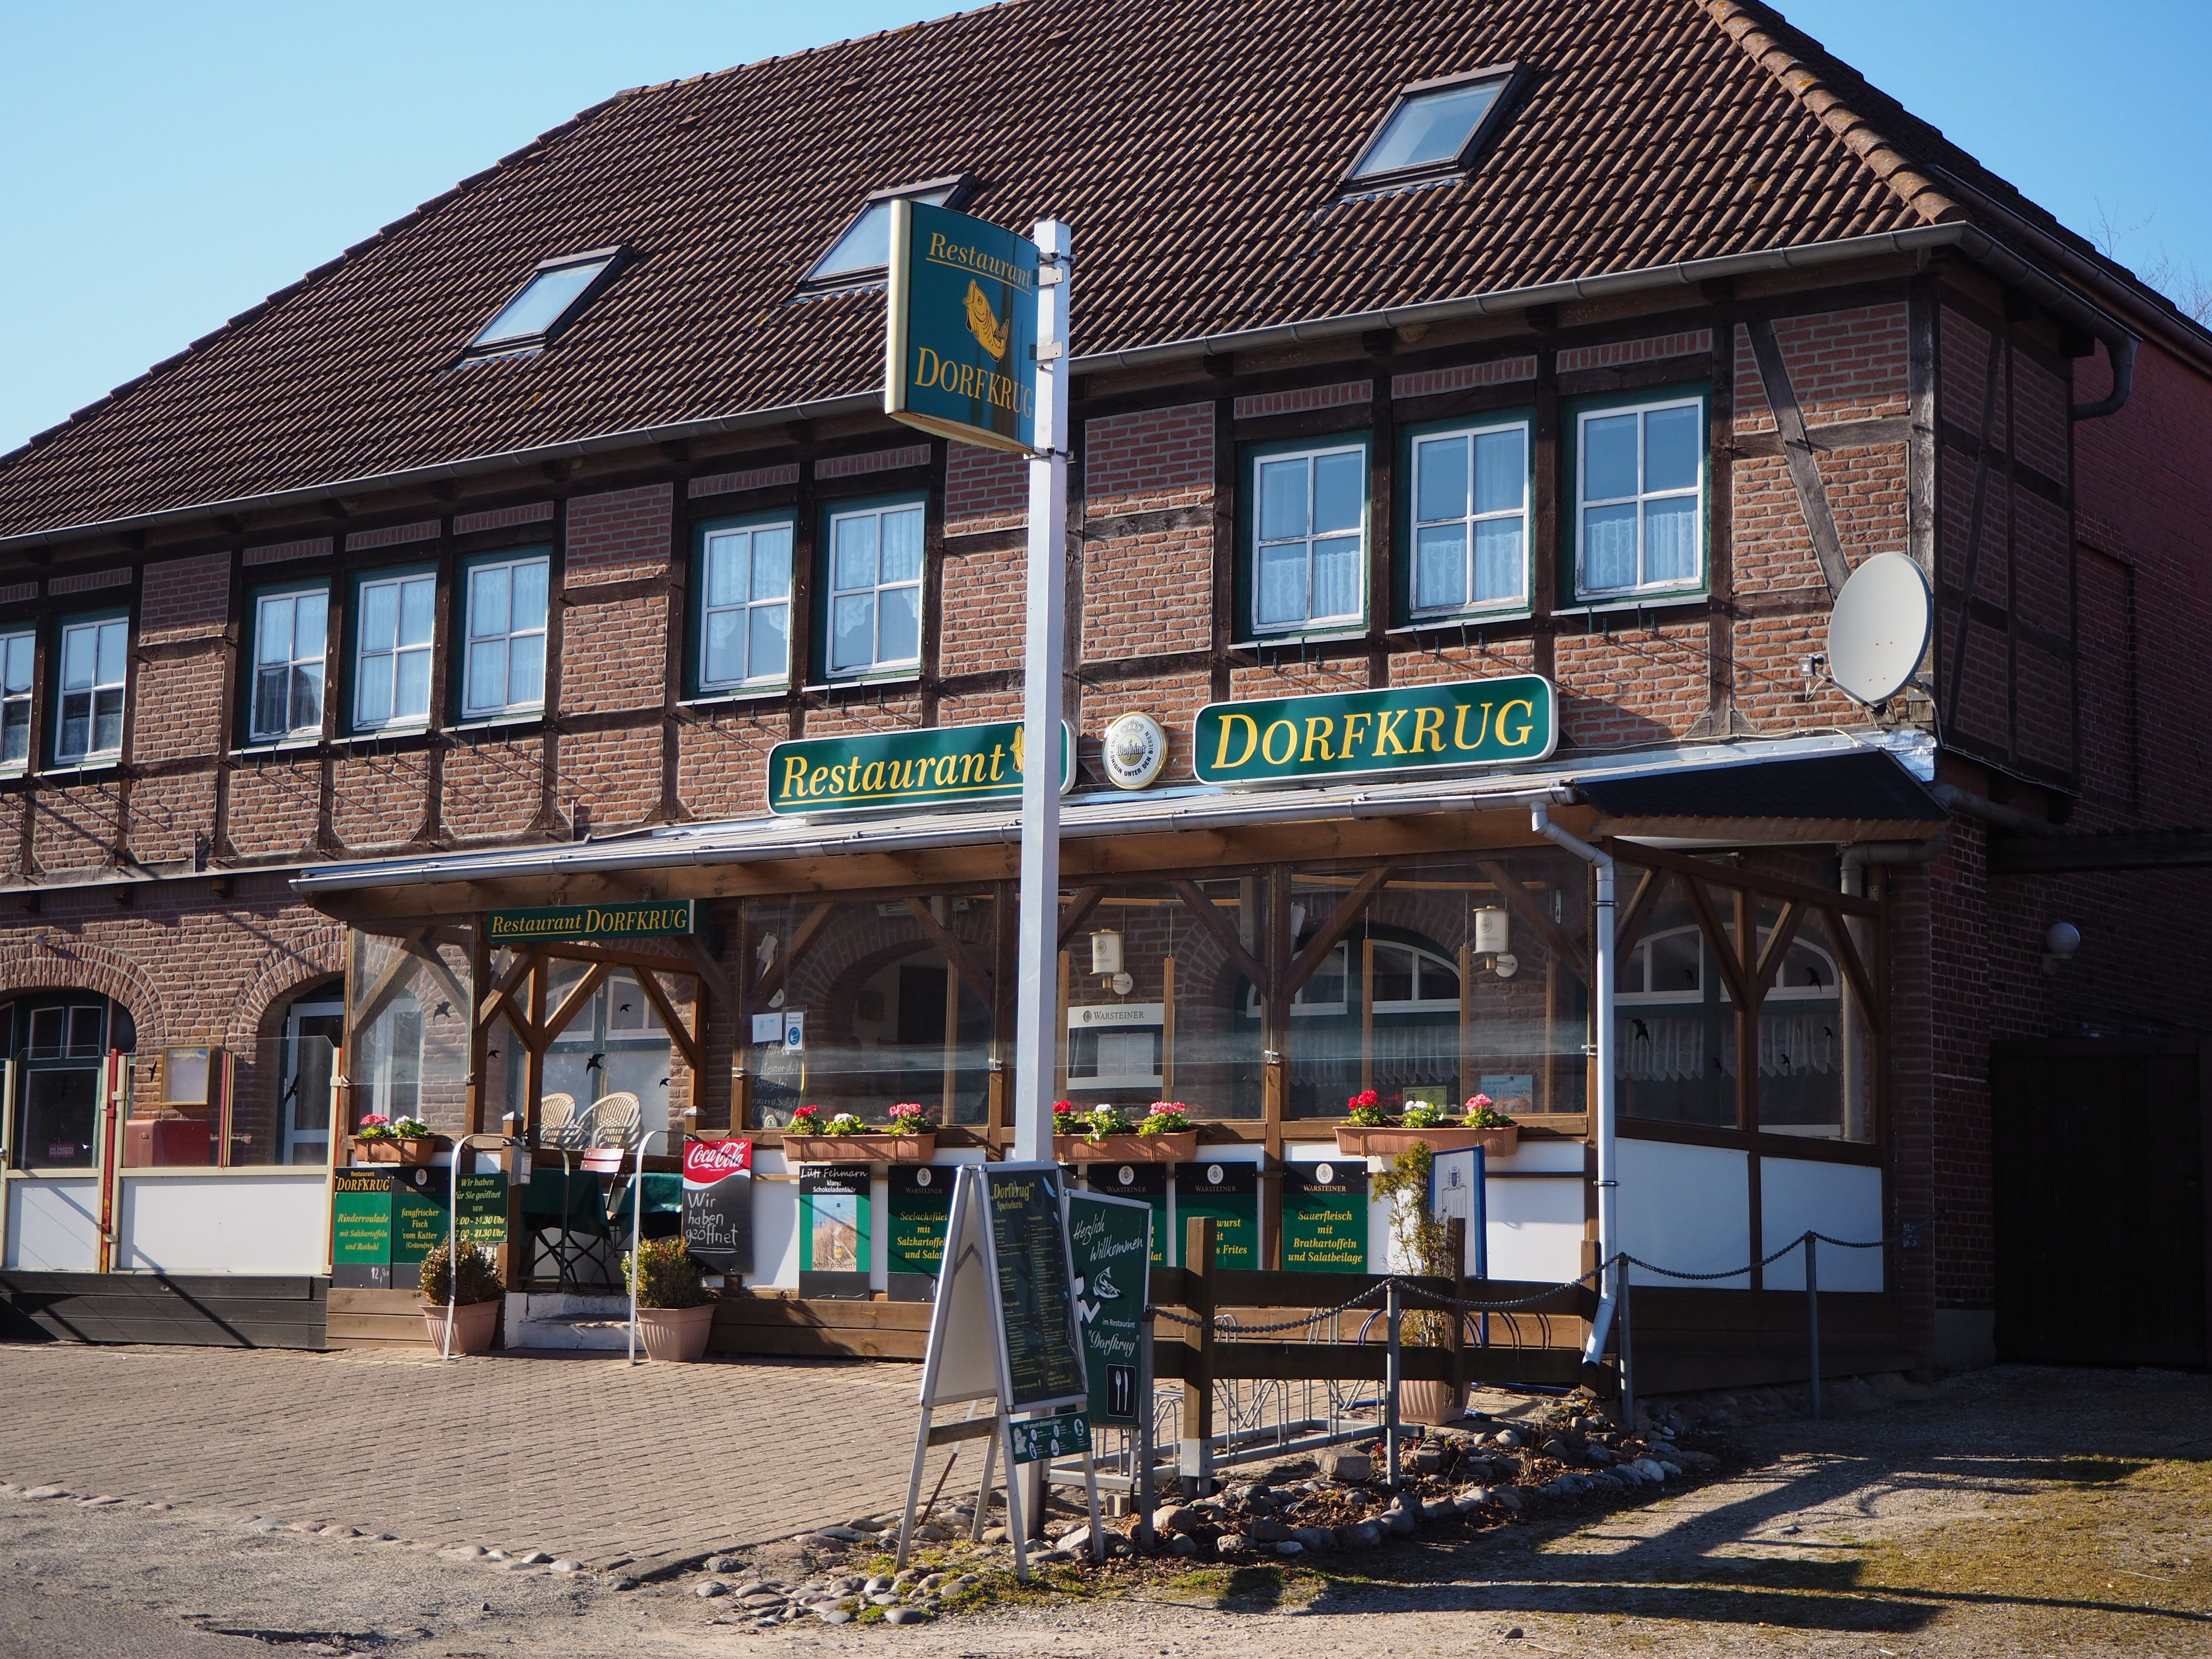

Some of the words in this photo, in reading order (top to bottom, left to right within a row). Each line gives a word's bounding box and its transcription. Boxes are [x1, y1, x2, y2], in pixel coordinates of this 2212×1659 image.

[929, 232, 1032, 289] Restaurant
[915, 347, 1033, 418] DORFKRUG
[1211, 699, 1533, 769] DORFKRUG
[1145, 731, 1154, 754] BIEREN
[1142, 757, 1152, 769] DEN
[780, 744, 1005, 798] Restaurant
[1124, 768, 1142, 777] UNTER
[492, 914, 582, 932] Restaurant
[584, 909, 687, 933] DORFKRUG
[1094, 1011, 1144, 1020] WARSTEINER
[800, 1168, 822, 1178] Lütt
[824, 1168, 868, 1178] Fehmarn
[337, 1178, 390, 1190] DORFKRUG
[474, 1178, 494, 1186] haben
[465, 1191, 475, 1199] Sie
[475, 1190, 501, 1201] geöffnet
[688, 1192, 716, 1208] Wir
[338, 1214, 388, 1223] Rinderroulade
[402, 1208, 439, 1218] fangfrischer
[688, 1209, 724, 1226] haben
[900, 1212, 948, 1222] Seelachsfilet
[1298, 1211, 1352, 1222] Sauerfleisch
[456, 1217, 469, 1225] 2.00
[475, 1216, 493, 1225] 14.30
[493, 1216, 505, 1224] Uhr
[1073, 1209, 1106, 1245] Herzlich
[1317, 1225, 1333, 1234] mit
[349, 1230, 387, 1239] Salzkartoffeln
[456, 1229, 469, 1238] 7.00
[685, 1223, 738, 1247] geöffnet
[897, 1237, 946, 1248] Salzkartoffel
[1294, 1238, 1357, 1250] Bratkartoffeln
[1090, 1235, 1143, 1262] Willkommen
[1223, 1244, 1247, 1254] Frites
[905, 1250, 920, 1258] und
[922, 1250, 942, 1259] Salat
[1288, 1251, 1306, 1262] und
[1308, 1252, 1363, 1264] Salatbeilage
[1110, 1319, 1135, 1328] Restaurant
